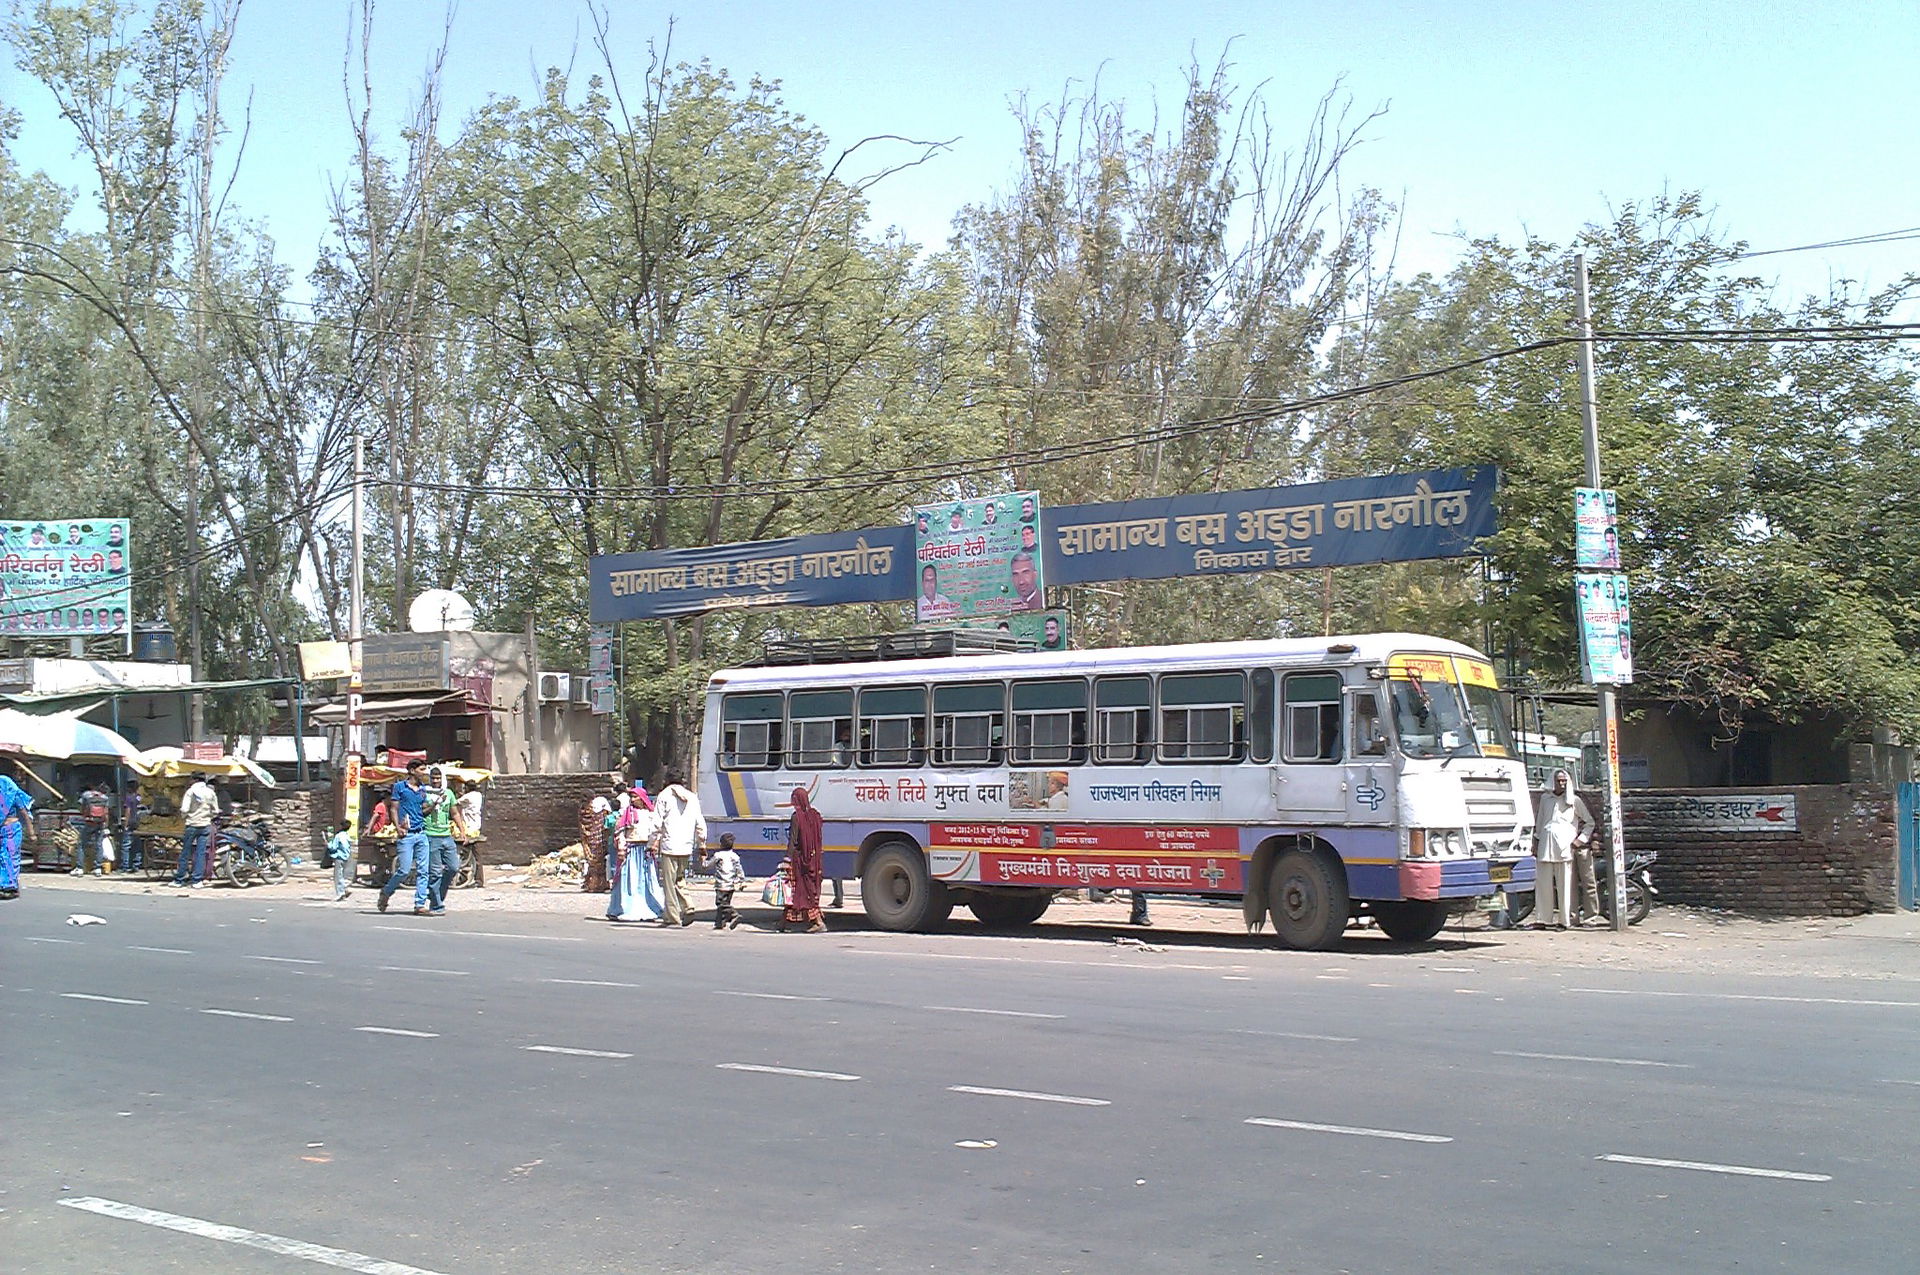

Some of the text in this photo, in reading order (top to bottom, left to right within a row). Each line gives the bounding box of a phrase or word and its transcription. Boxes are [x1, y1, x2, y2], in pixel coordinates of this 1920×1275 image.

[1058, 479, 1472, 556] सामान्य बस अड्डा नारनौल
[918, 535, 986, 562] परिवर्तन रैली
[1194, 546, 1313, 571] निकास द्वार
[69, 553, 105, 573] रैली
[610, 537, 894, 597] सामान्य बस अड्डा नारनौल
[855, 777, 1005, 810] सबके लिये मुफ्त दवा
[1090, 779, 1222, 803] राजस्थान परिवहन निगम
[762, 827, 779, 841] थार
[998, 856, 1052, 880] मुख्यमंत्री
[1114, 863, 1141, 881] दवा
[1146, 859, 1192, 881] योजना
